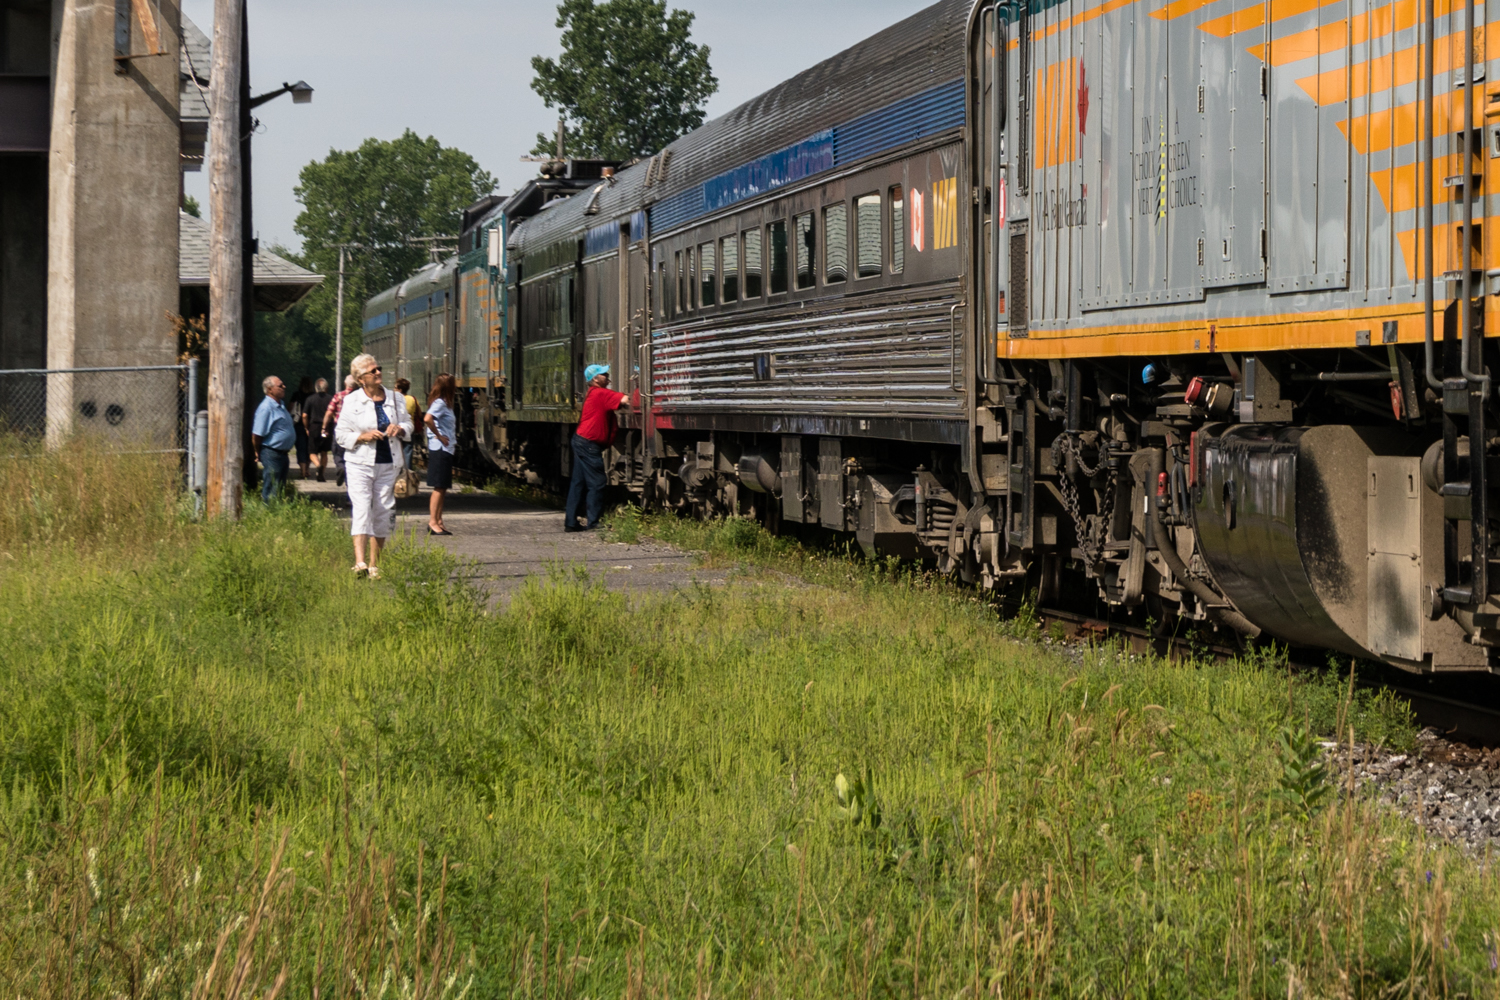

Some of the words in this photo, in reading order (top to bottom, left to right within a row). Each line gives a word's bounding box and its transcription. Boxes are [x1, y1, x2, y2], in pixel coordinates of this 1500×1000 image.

[1035, 56, 1077, 170] VIA
[1142, 115, 1152, 145] UN
[1168, 139, 1190, 173] GREEN
[1169, 175, 1197, 209] CHOICE
[932, 176, 957, 250] VIA
